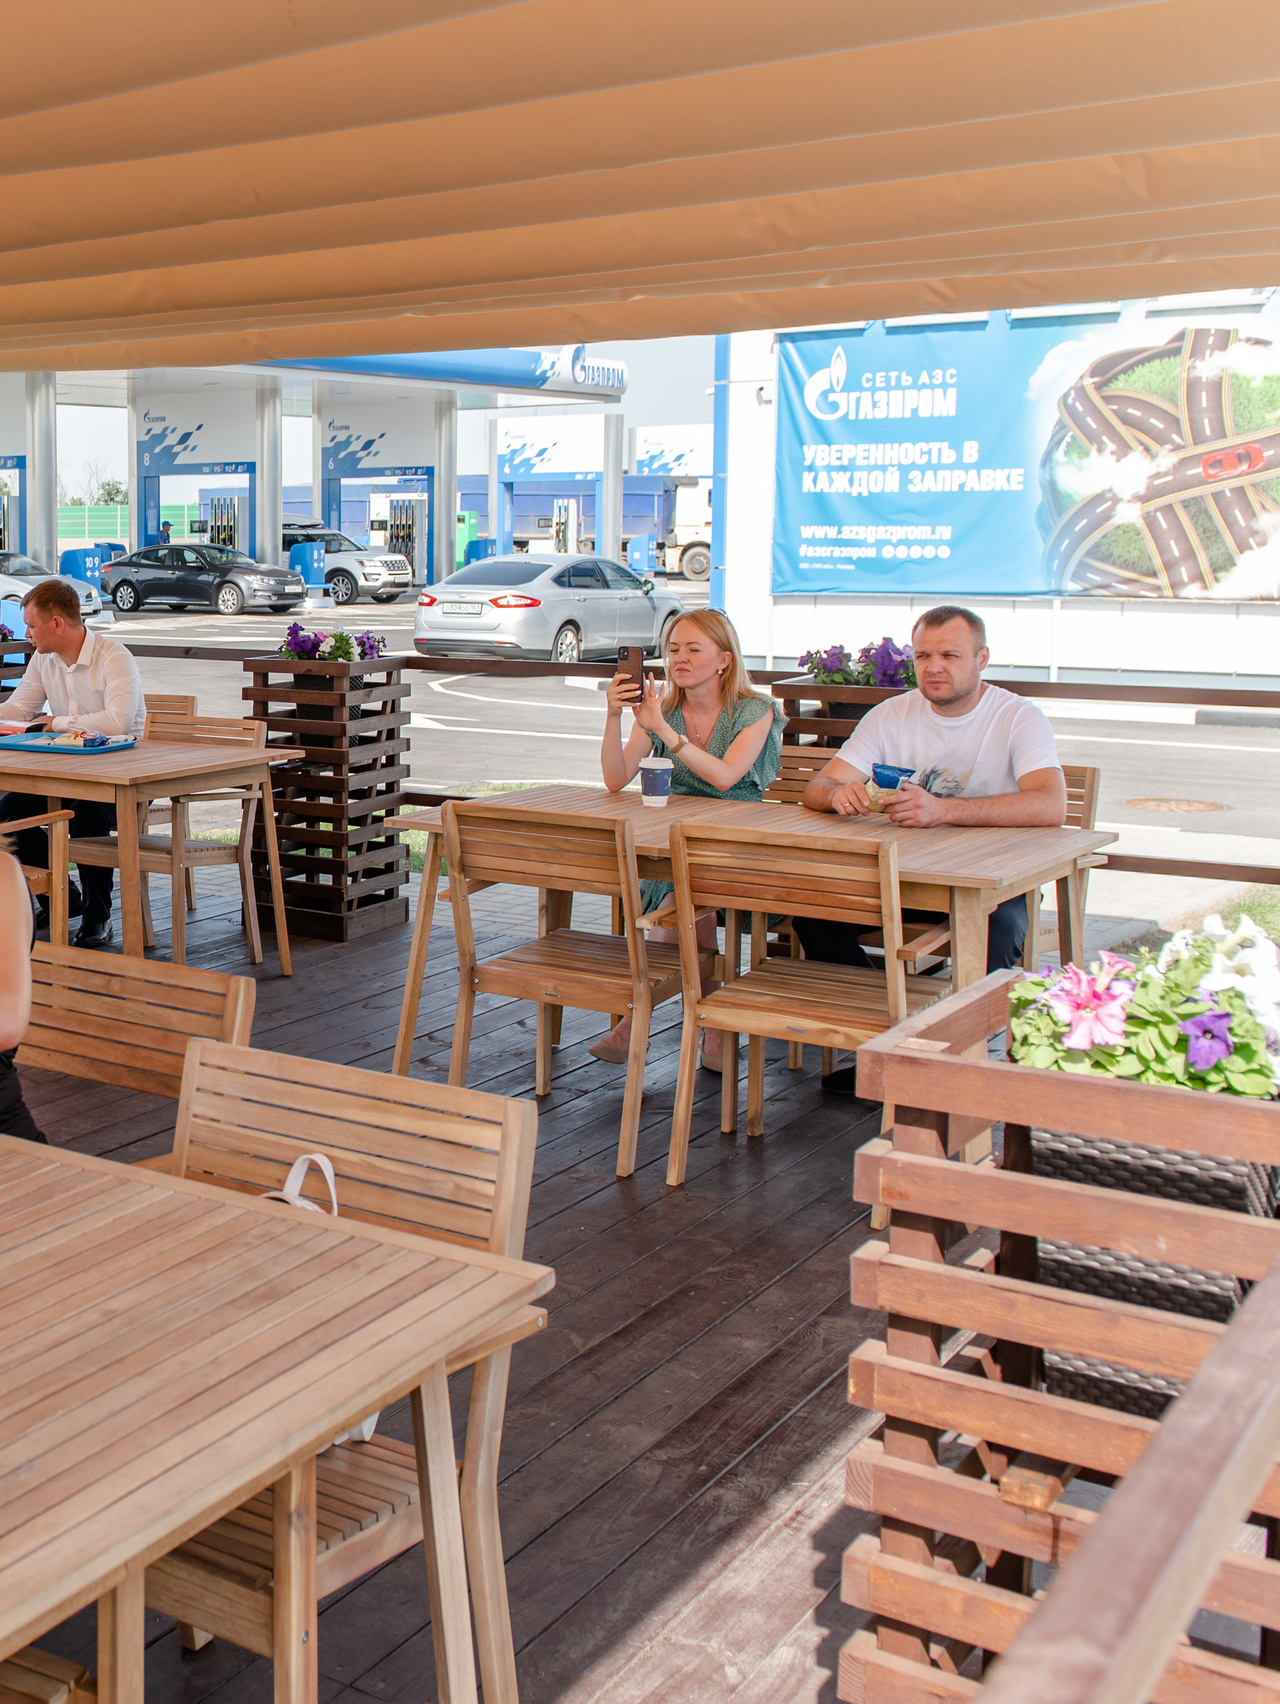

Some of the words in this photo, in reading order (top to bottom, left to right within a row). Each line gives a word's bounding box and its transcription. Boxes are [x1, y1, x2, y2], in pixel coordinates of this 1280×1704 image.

[861, 371, 913, 388] СЕТЬ
[918, 368, 957, 386] АЗС
[848, 387, 957, 420] ГАЗПРОМ
[143, 452, 150, 466] 8
[802, 442, 956, 466] УВЕРЕННОСТЬ
[962, 440, 979, 463] В
[328, 457, 335, 470] 6
[503, 462, 511, 474] 4
[802, 466, 900, 496] КАЖДОЙ
[908, 468, 1024, 492] ЗАПРАВКЕ
[800, 525, 952, 543] www.azsgazprom.ru
[85, 557, 94, 568] 10
[94, 557, 99, 568] 9
[313, 550, 318, 560] 8
[320, 550, 325, 560] 7
